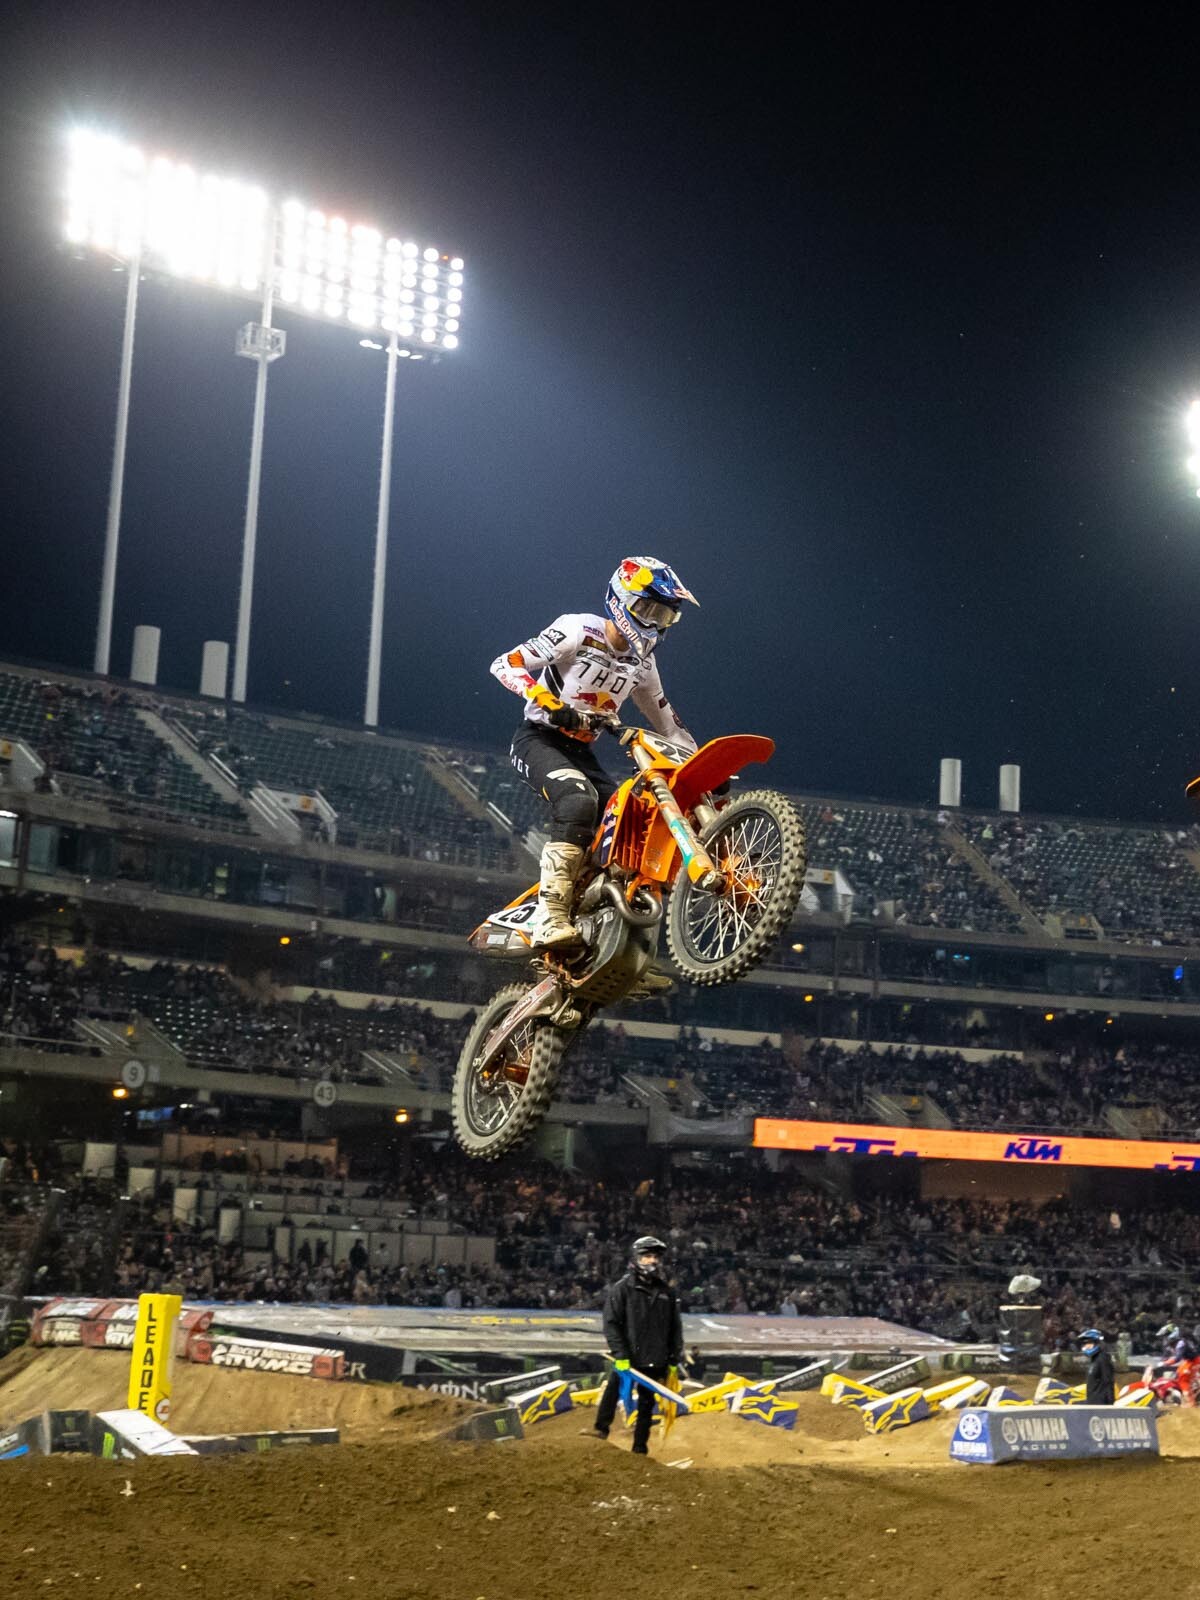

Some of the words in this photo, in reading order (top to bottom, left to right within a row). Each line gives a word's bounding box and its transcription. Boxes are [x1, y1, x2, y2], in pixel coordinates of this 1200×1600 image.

[1004, 1137, 1064, 1161] KTM
[138, 1303, 157, 1411] LEADE
[1016, 1417, 1070, 1441] YAMAHA
[1103, 1416, 1152, 1440] YAMAHA
